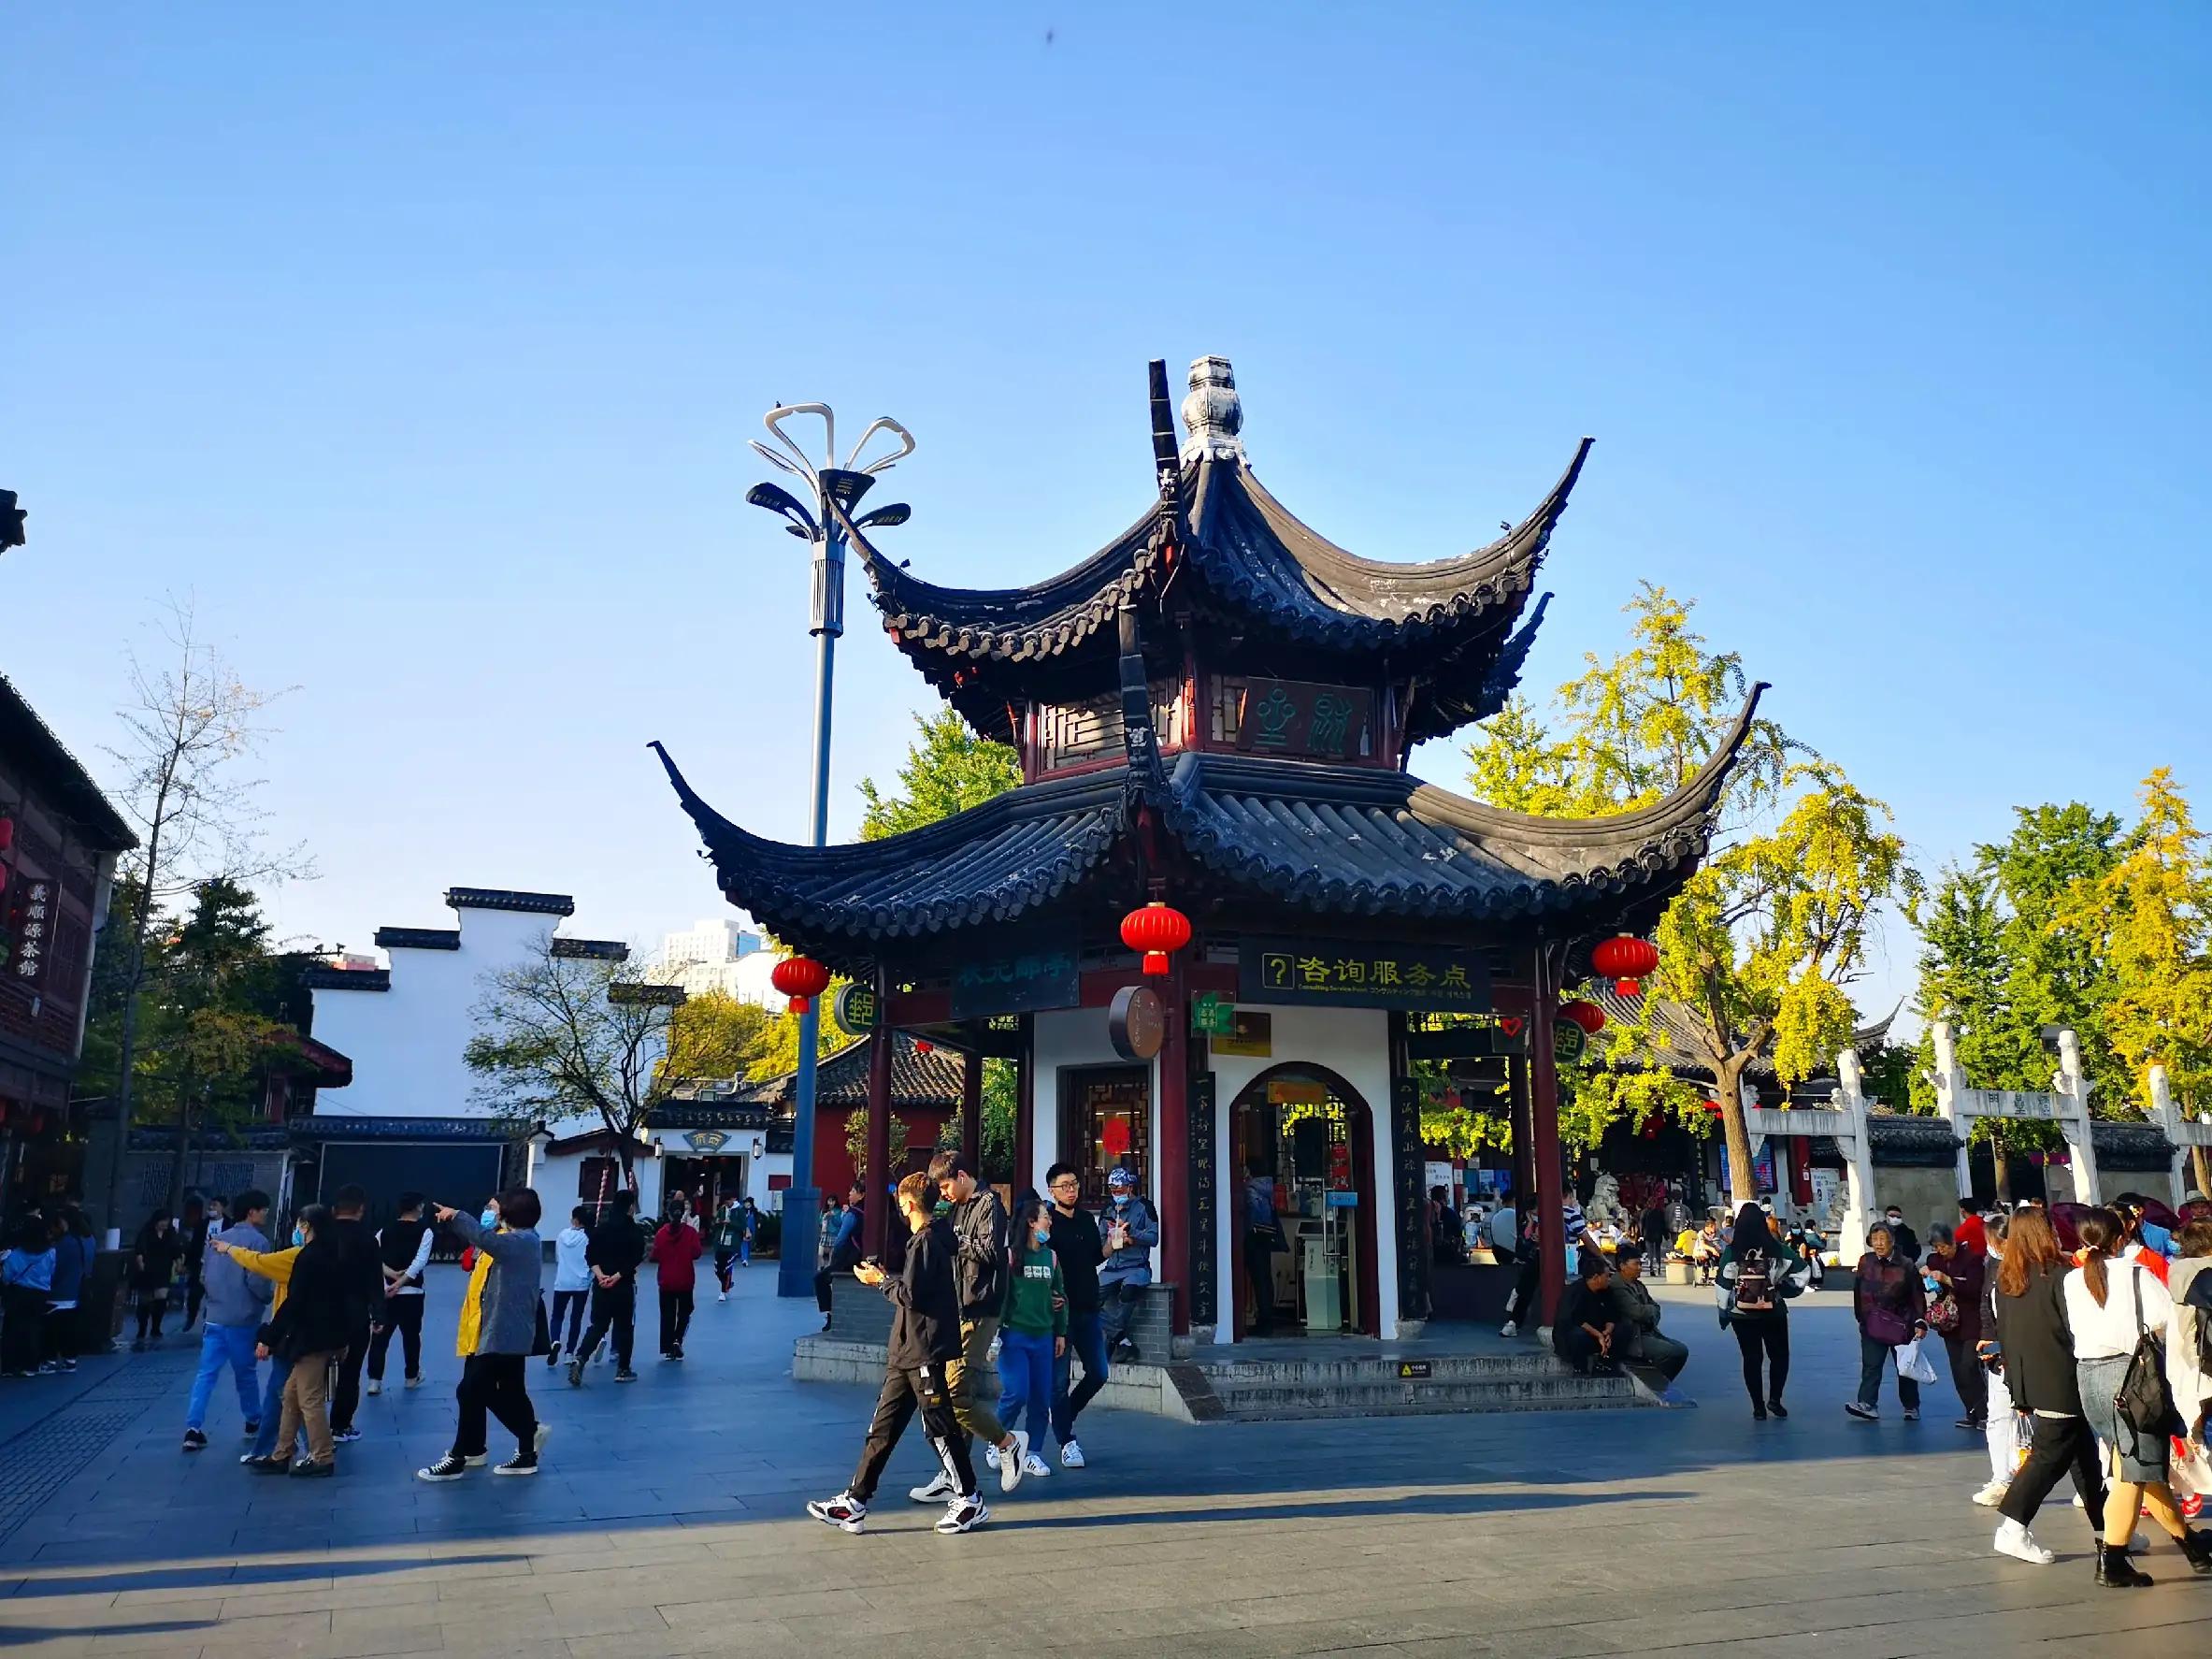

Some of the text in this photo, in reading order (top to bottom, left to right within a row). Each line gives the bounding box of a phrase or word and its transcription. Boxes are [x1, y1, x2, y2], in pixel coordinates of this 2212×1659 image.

[1297, 957, 1472, 989] 咨询服务点
